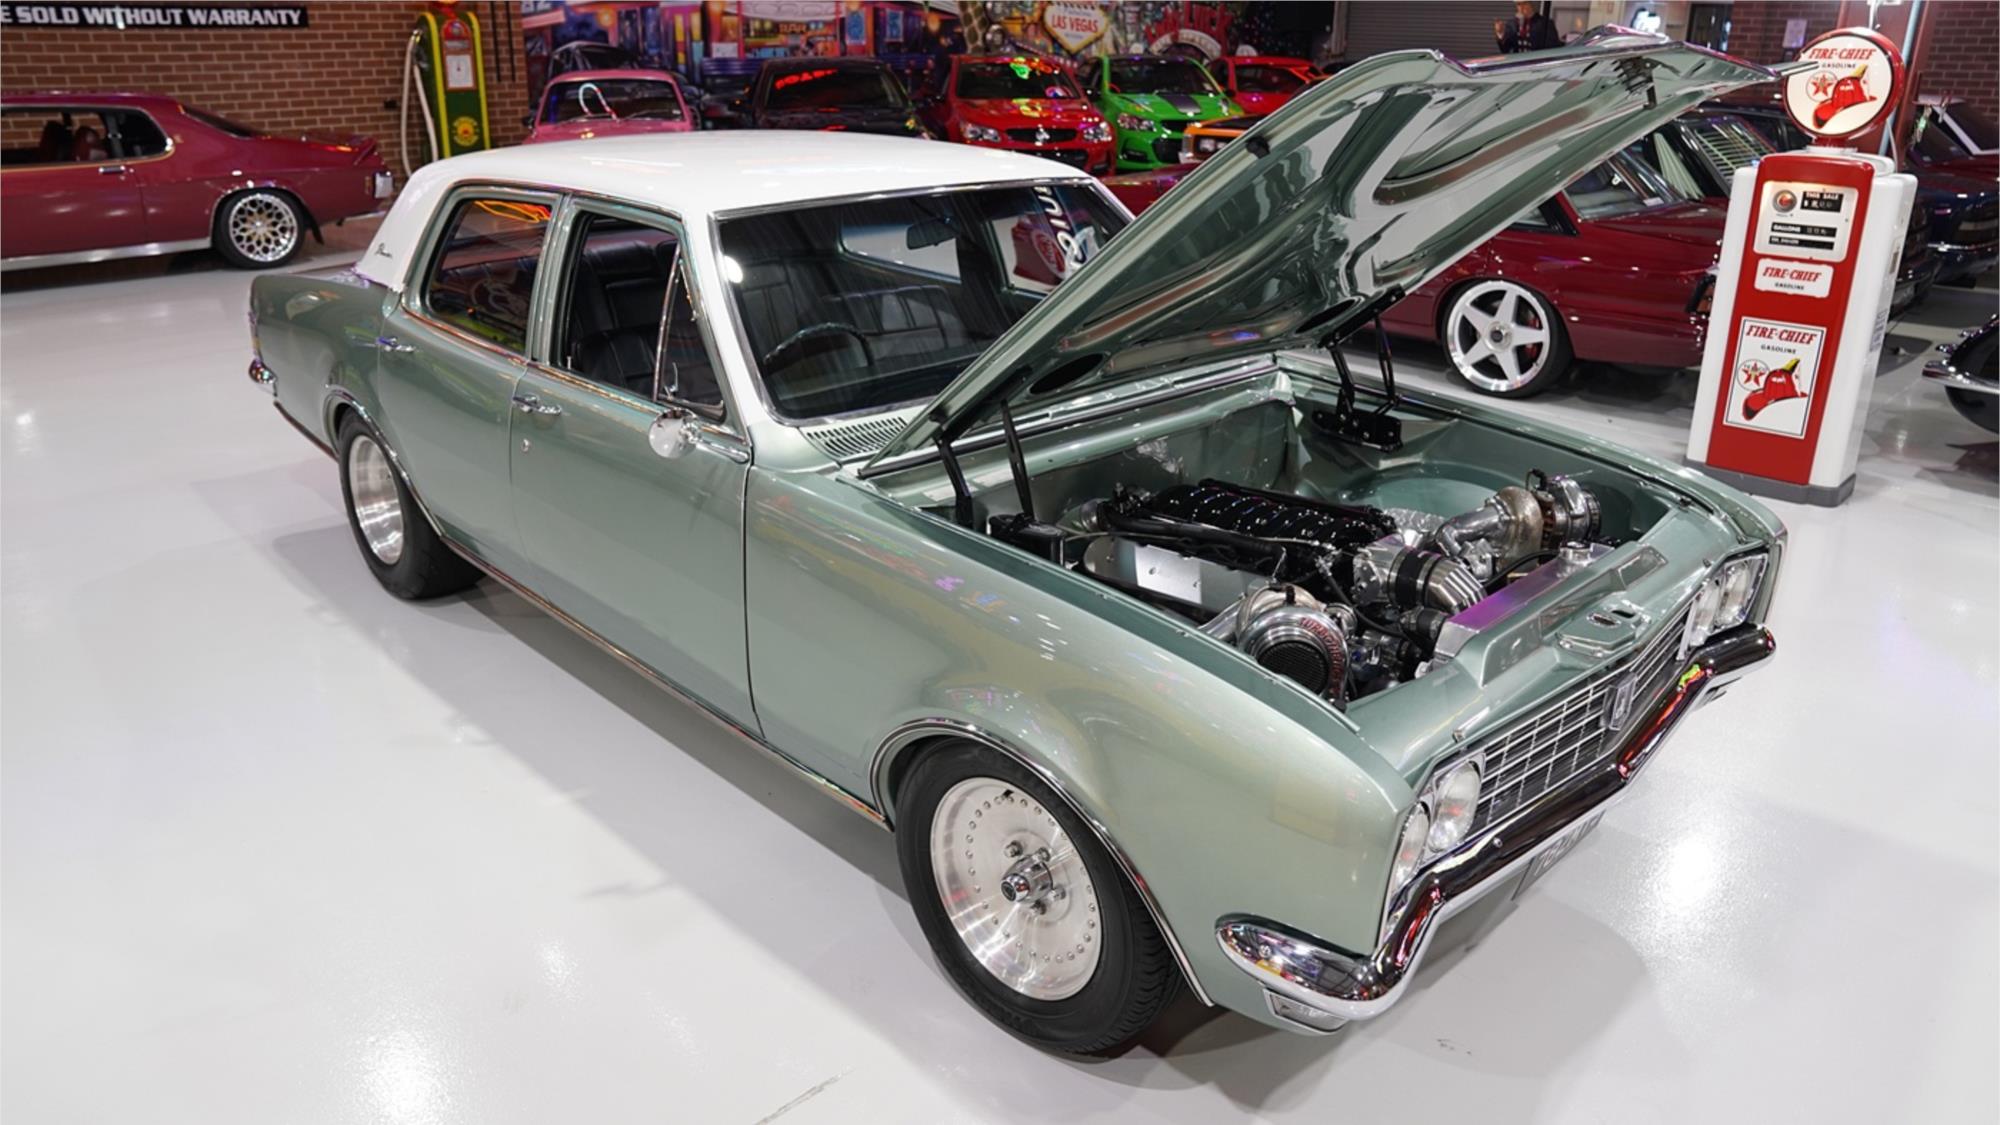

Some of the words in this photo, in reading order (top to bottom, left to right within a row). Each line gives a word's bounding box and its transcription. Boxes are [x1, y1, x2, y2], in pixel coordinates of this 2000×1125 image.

[16, 6, 79, 24] SOLD
[82, 7, 183, 25] WITHOUT
[187, 9, 301, 25] WARRANTY
[1052, 14, 1067, 29] LAS
[1069, 17, 1099, 33] VEGAS
[1808, 48, 1877, 60] FIRE-CHIEF
[1763, 266, 1822, 283] FIRE-CHIEF
[1774, 282, 1805, 291] GASOLINE
[1746, 325, 1817, 345] FIRE-CHIEF
[1760, 344, 1797, 354] GASOLINE
